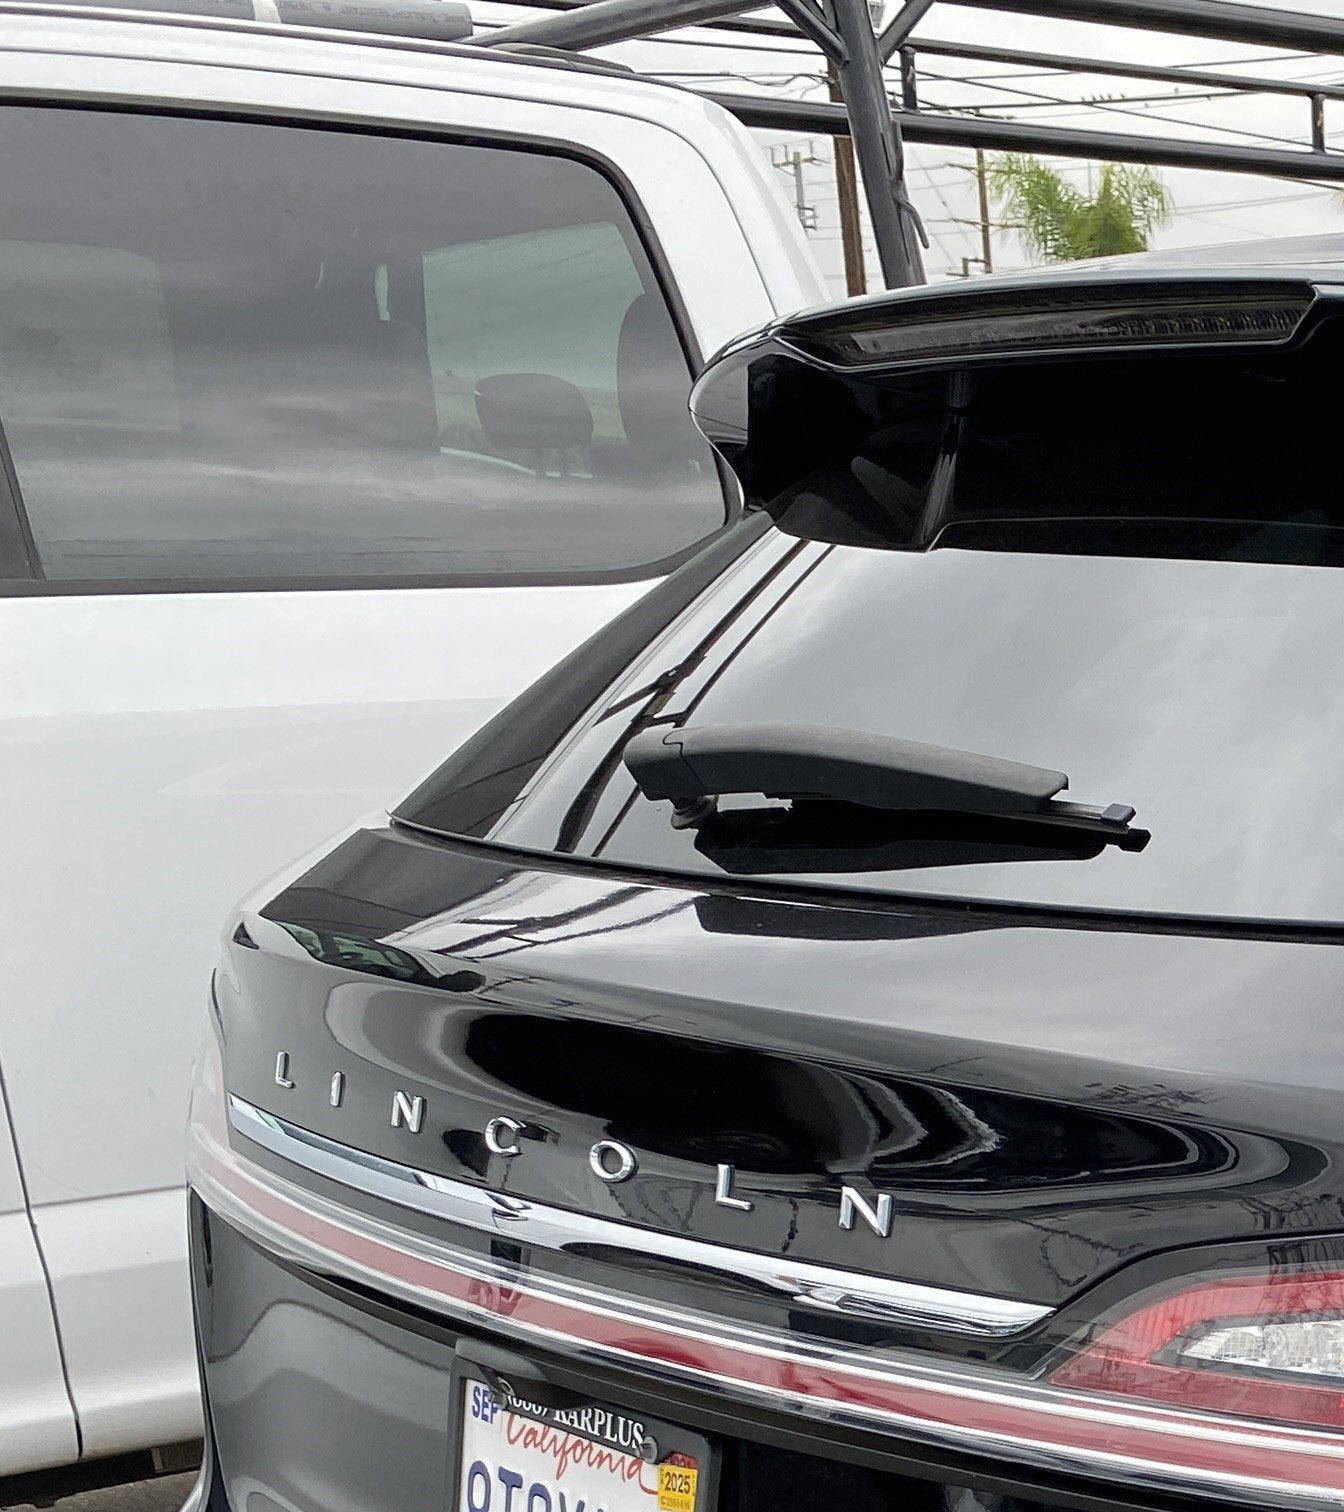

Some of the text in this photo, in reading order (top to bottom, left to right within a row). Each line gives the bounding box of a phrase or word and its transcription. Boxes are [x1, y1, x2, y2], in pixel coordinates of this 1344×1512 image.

[275, 1050, 894, 1238] LINCOLN
[504, 1412, 658, 1495] California
[663, 1470, 691, 1495] 2025
